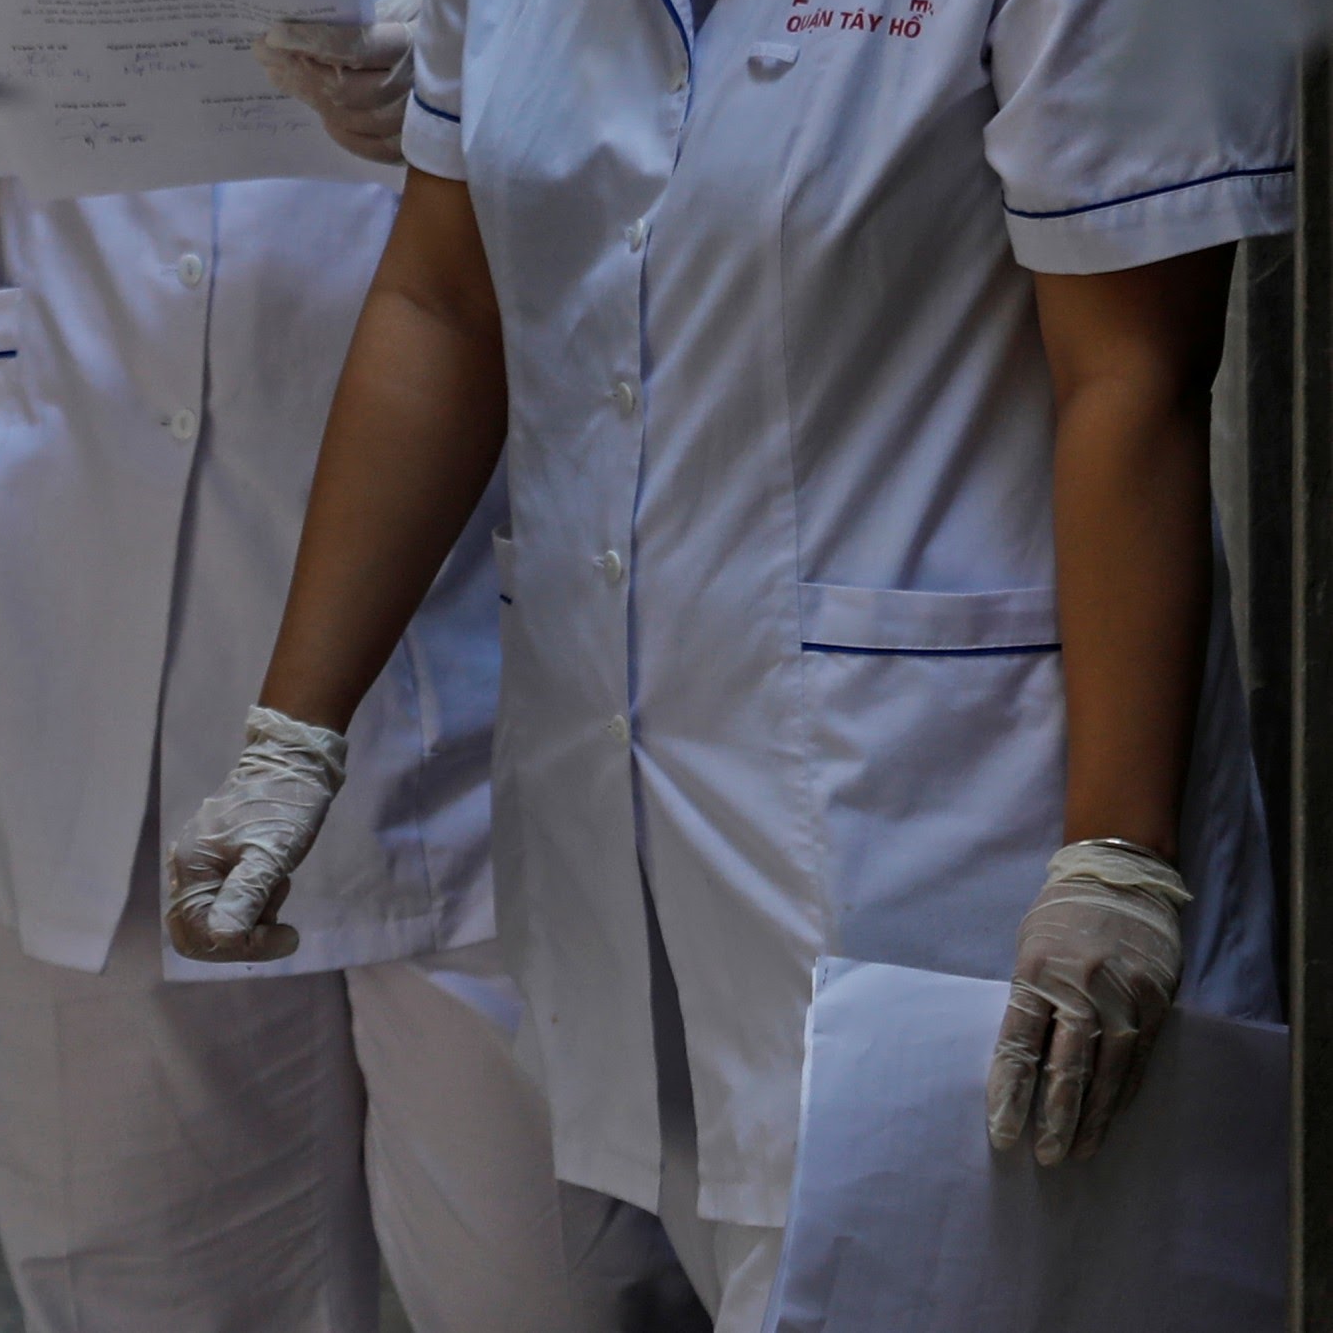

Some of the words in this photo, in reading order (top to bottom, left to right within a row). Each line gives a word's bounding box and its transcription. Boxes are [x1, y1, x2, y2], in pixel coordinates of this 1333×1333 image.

[786, 8, 834, 34] QUẬN
[840, 8, 883, 33] TÂY
[889, 13, 922, 39] HỒ
